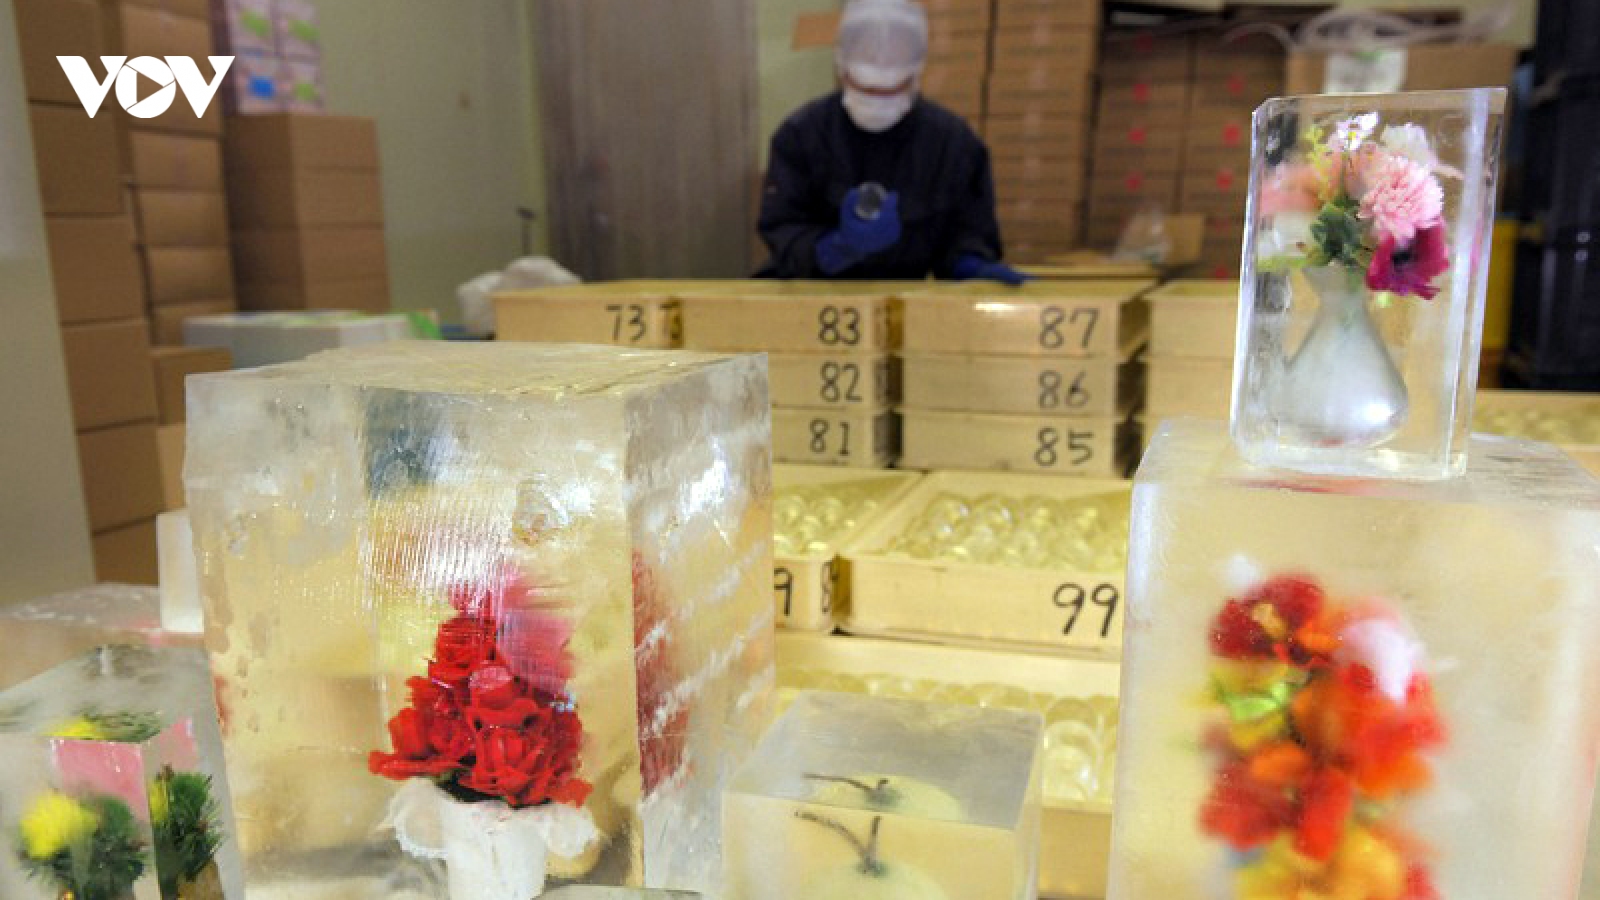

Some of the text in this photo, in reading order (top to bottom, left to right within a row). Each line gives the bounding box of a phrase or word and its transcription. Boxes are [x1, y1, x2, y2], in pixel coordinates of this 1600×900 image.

[605, 304, 647, 342] 73
[818, 305, 861, 346] 83
[1038, 305, 1100, 349] 87
[820, 361, 863, 403] 82
[1037, 370, 1090, 410] 86
[809, 418, 850, 457] 81
[1033, 427, 1095, 468] 85
[1052, 582, 1119, 638] 99
